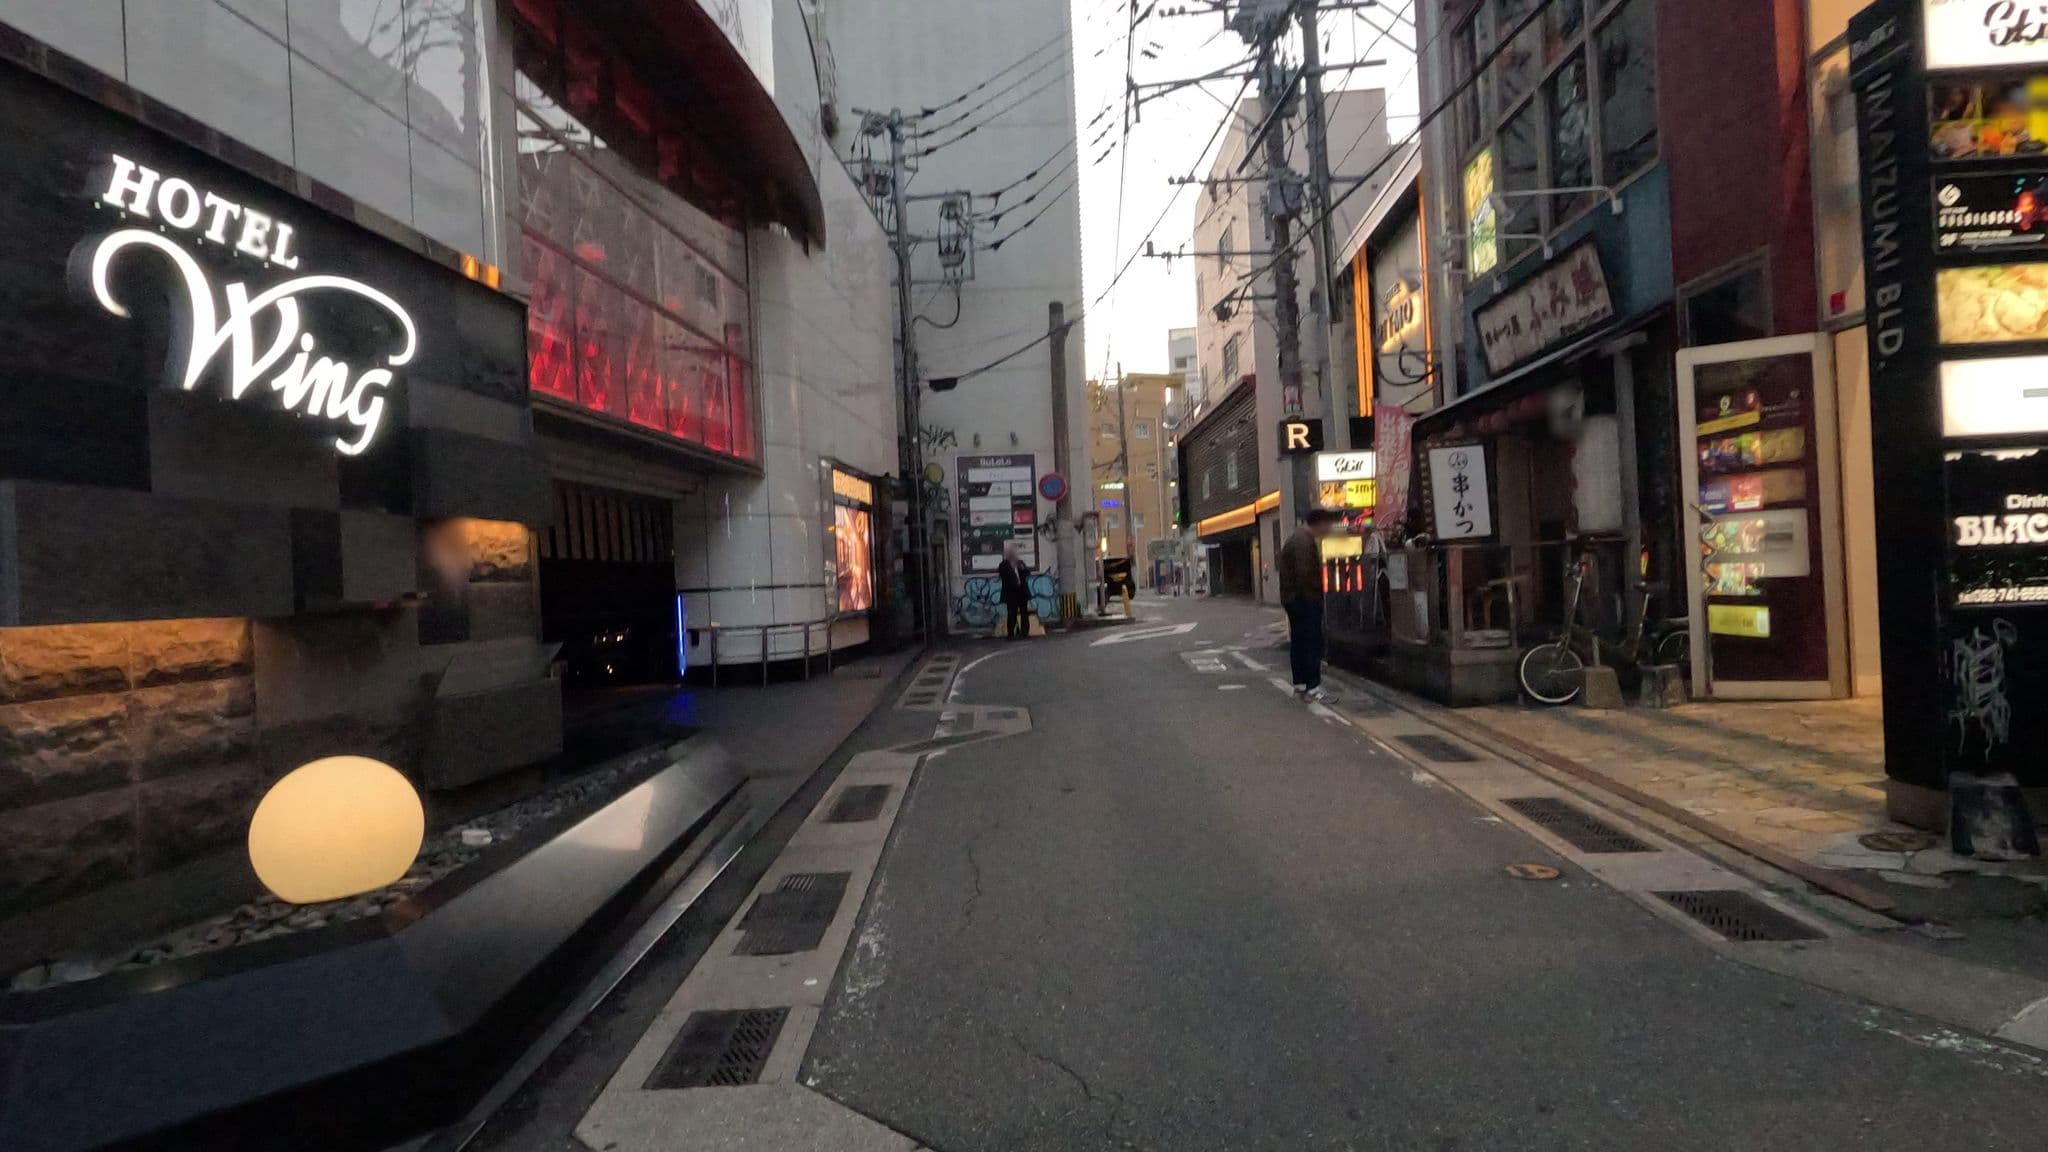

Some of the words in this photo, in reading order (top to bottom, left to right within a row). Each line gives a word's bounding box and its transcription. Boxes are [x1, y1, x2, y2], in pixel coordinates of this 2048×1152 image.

[102, 154, 299, 270] HOTEL
[1866, 72, 1902, 271] IMAIZUMI
[92, 229, 417, 456] Wing
[1874, 282, 1904, 369] BLD.
[1286, 423, 1311, 449] R
[1451, 472, 1474, 535] 串かつ
[1954, 512, 2048, 546] BLAC
